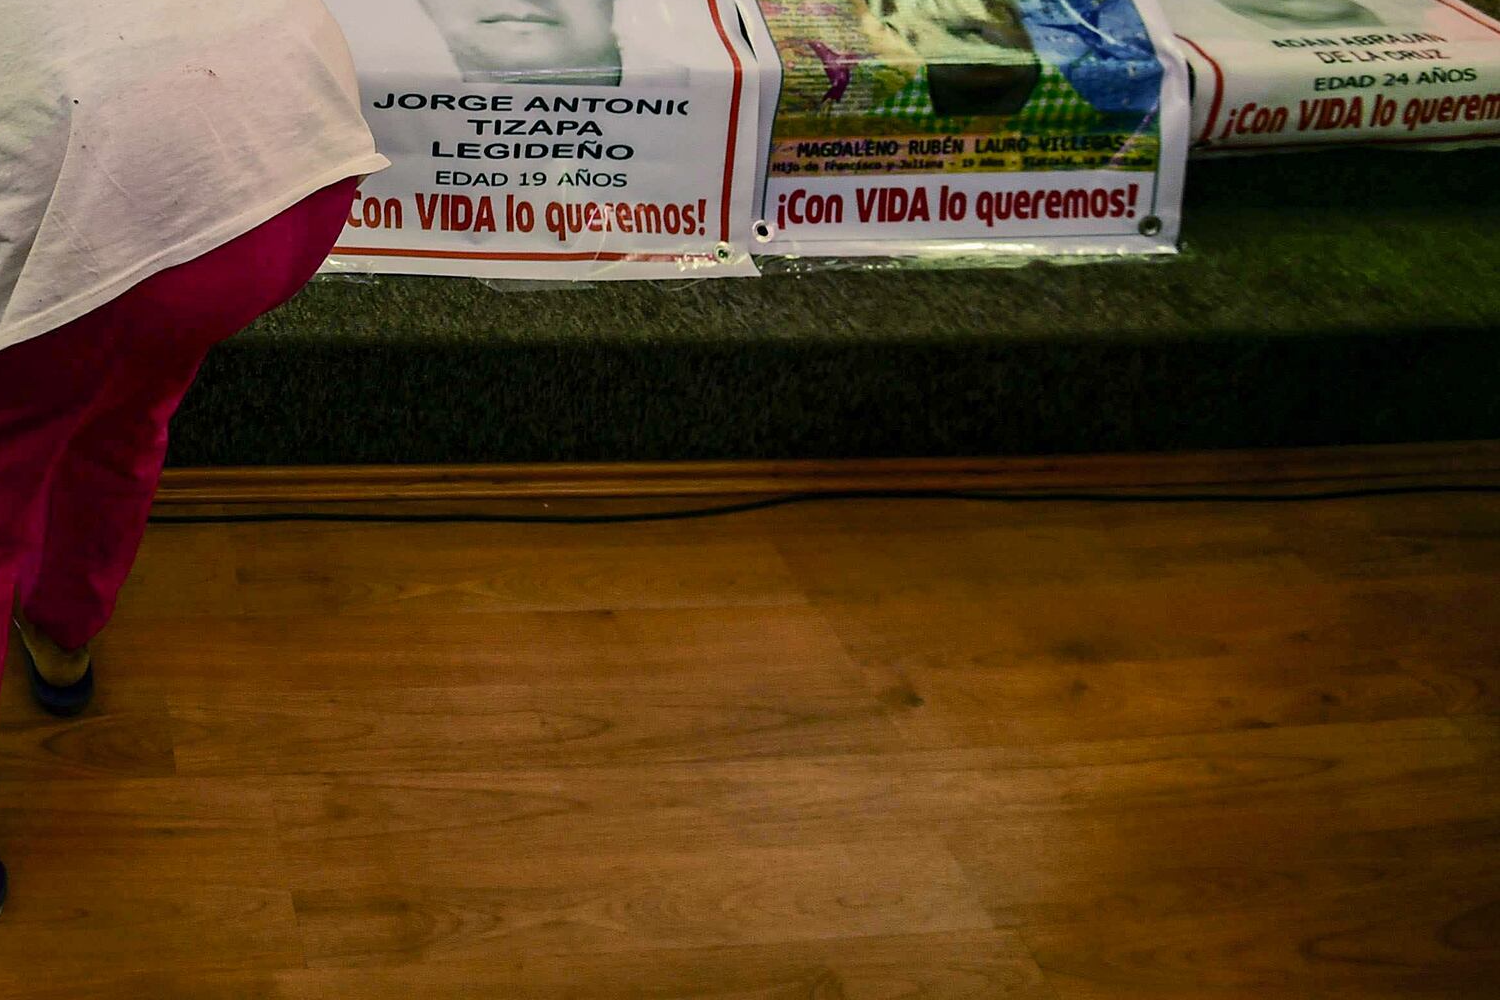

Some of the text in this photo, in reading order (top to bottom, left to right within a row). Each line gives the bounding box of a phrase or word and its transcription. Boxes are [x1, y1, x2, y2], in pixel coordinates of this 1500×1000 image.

[1315, 49, 1451, 63] DE LA CRUZ
[1314, 67, 1477, 91] EDAD 24 AÑOS
[374, 94, 513, 111] JORGE
[1219, 94, 1398, 139] ¡Con VIDA lo
[467, 119, 603, 136] TIZAPA
[432, 140, 635, 161] LEGIDEÑO
[797, 136, 1027, 158] MAGDALENO RUBÉN LAURO
[436, 168, 627, 187] EDAD 19 AÑOS
[415, 193, 706, 241] VIDA lo queremos!
[777, 185, 1137, 231] ¡Con VIDA lo queremos!
